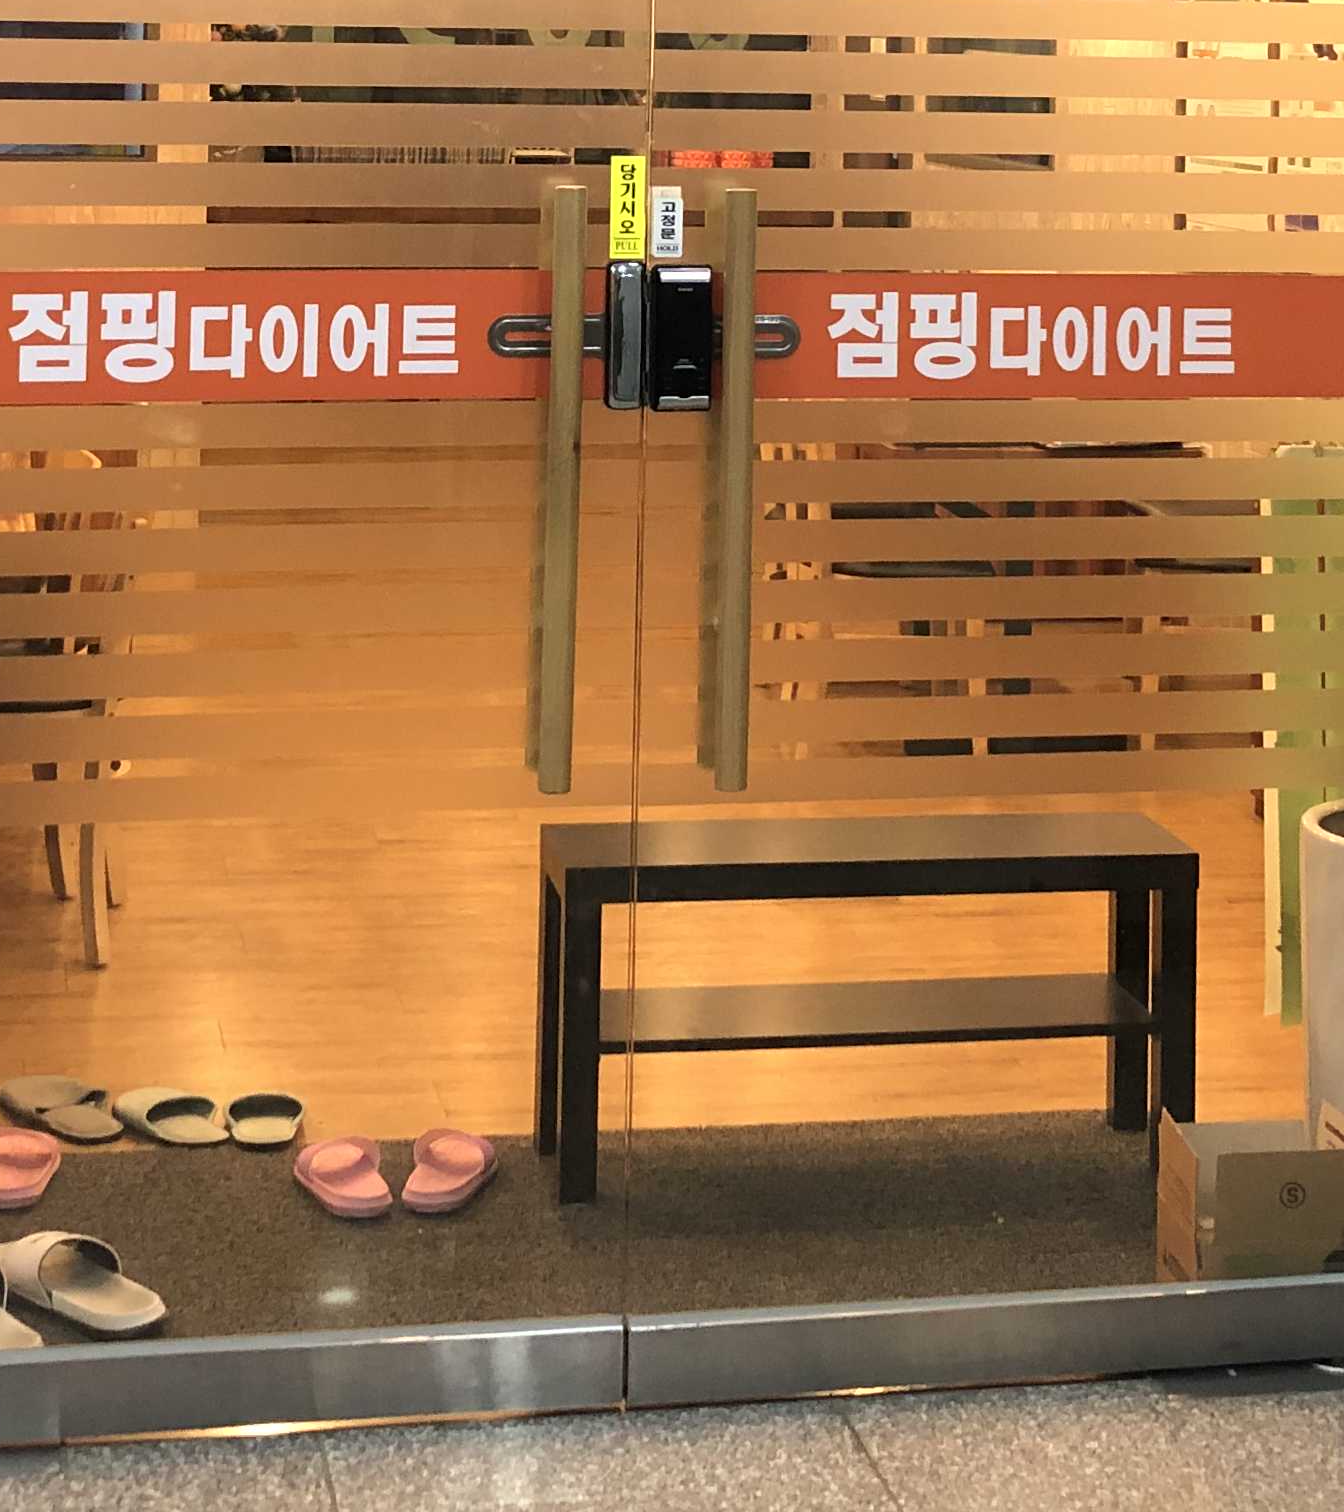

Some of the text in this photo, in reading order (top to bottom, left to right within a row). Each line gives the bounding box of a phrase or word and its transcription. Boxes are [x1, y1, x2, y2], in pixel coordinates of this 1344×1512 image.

[619, 163, 637, 235] 당기시오
[660, 201, 676, 240] 고정문
[615, 240, 638, 251] PULL
